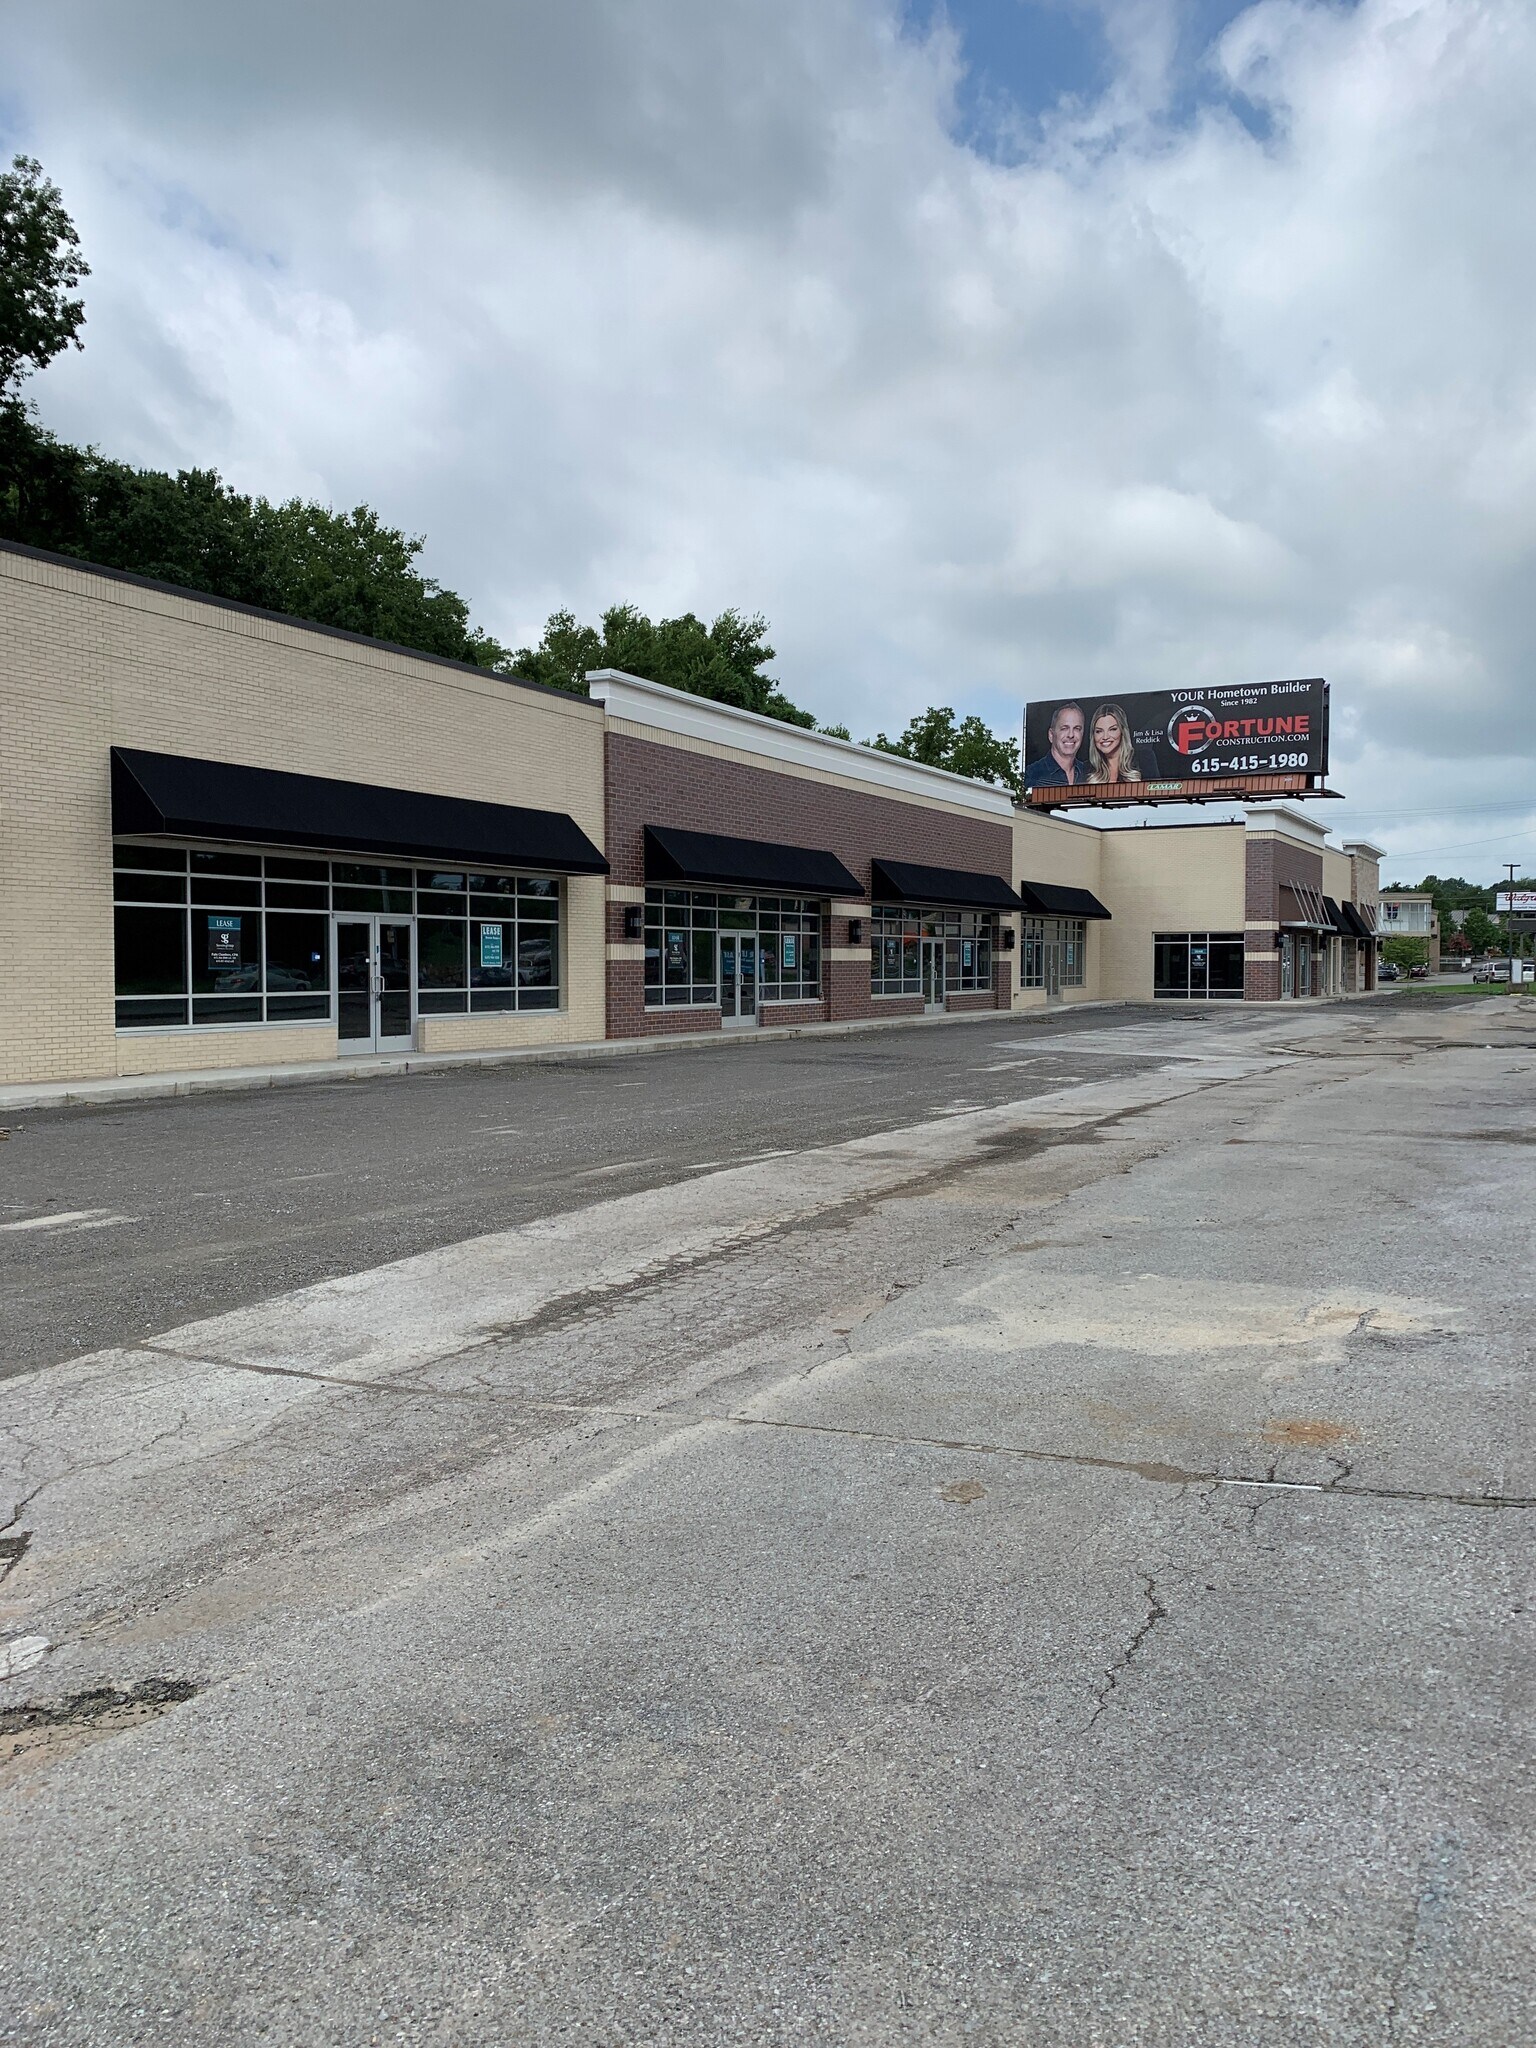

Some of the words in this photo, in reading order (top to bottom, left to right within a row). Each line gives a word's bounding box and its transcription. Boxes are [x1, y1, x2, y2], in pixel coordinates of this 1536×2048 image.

[1171, 690, 1204, 702] YOUR
[1207, 686, 1267, 700] Hometown
[1271, 682, 1312, 695] Builder
[1220, 699, 1239, 707] Since
[1241, 697, 1258, 705] 1982
[1133, 730, 1144, 738] Jim
[1135, 736, 1161, 744] Reddick
[1216, 734, 1310, 747] CONSTRUCTION.COM
[1191, 752, 1309, 773] 615-415-1980
[216, 919, 233, 927] LEASE
[483, 926, 500, 935] LEASE
